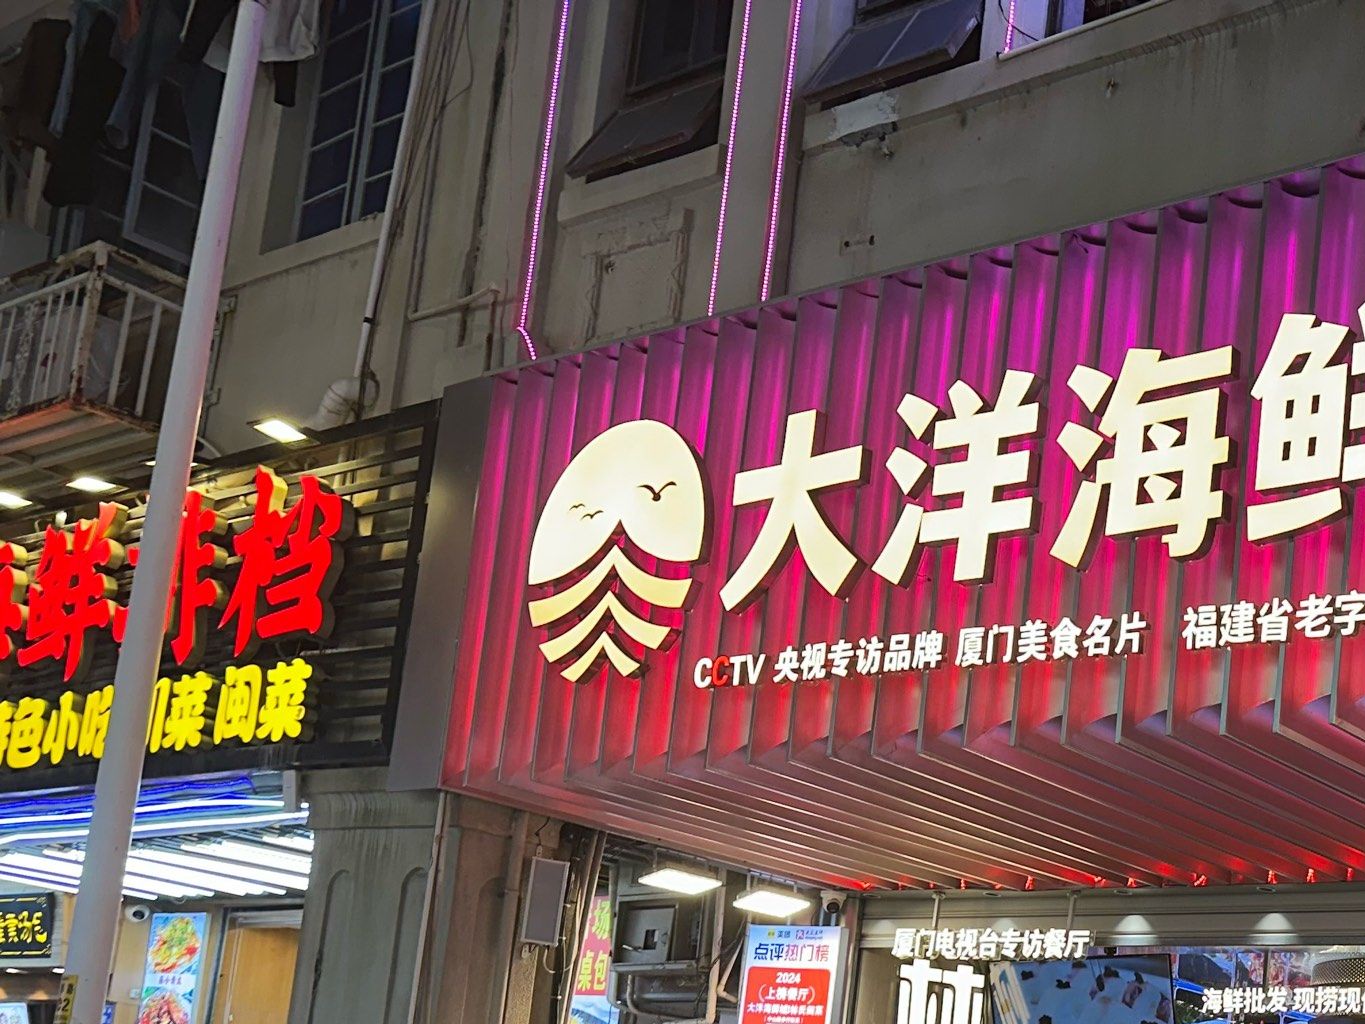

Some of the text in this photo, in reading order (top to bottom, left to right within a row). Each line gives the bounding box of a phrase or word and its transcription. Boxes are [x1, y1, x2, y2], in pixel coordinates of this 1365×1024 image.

[693, 653, 766, 689] CCTV
[772, 629, 944, 684] 央视专访品牌
[954, 611, 1148, 667] 厦门美食名片
[753, 942, 830, 962] 点评热门榜
[890, 927, 1091, 960] 厦门电视台专访餐厅
[775, 971, 801, 984] 2024
[1201, 987, 1287, 1014] 海鲜批发
